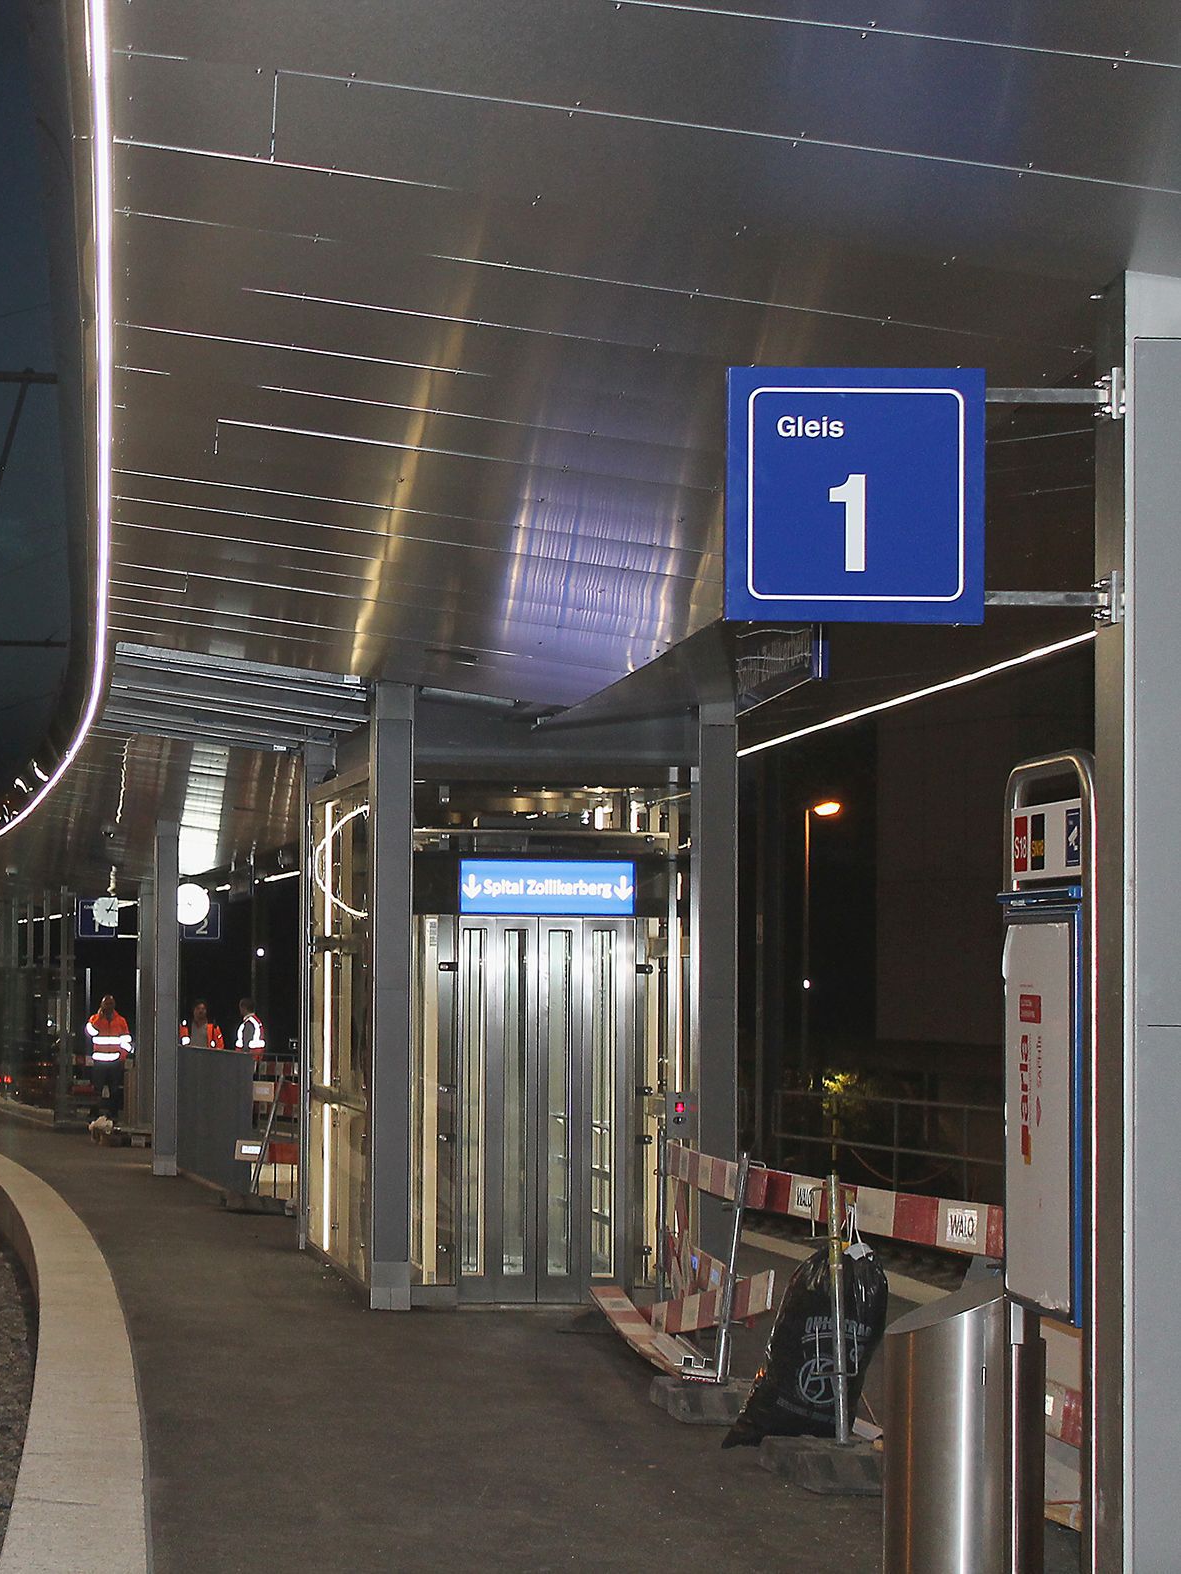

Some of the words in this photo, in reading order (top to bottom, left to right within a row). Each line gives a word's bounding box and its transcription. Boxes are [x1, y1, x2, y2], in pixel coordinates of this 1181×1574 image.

[776, 415, 844, 437] Gleis
[828, 473, 867, 572] 1
[1014, 836, 1027, 859] S18
[483, 878, 524, 898] Spital
[526, 879, 612, 899] Zollikerberg
[949, 1213, 974, 1238] WALO
